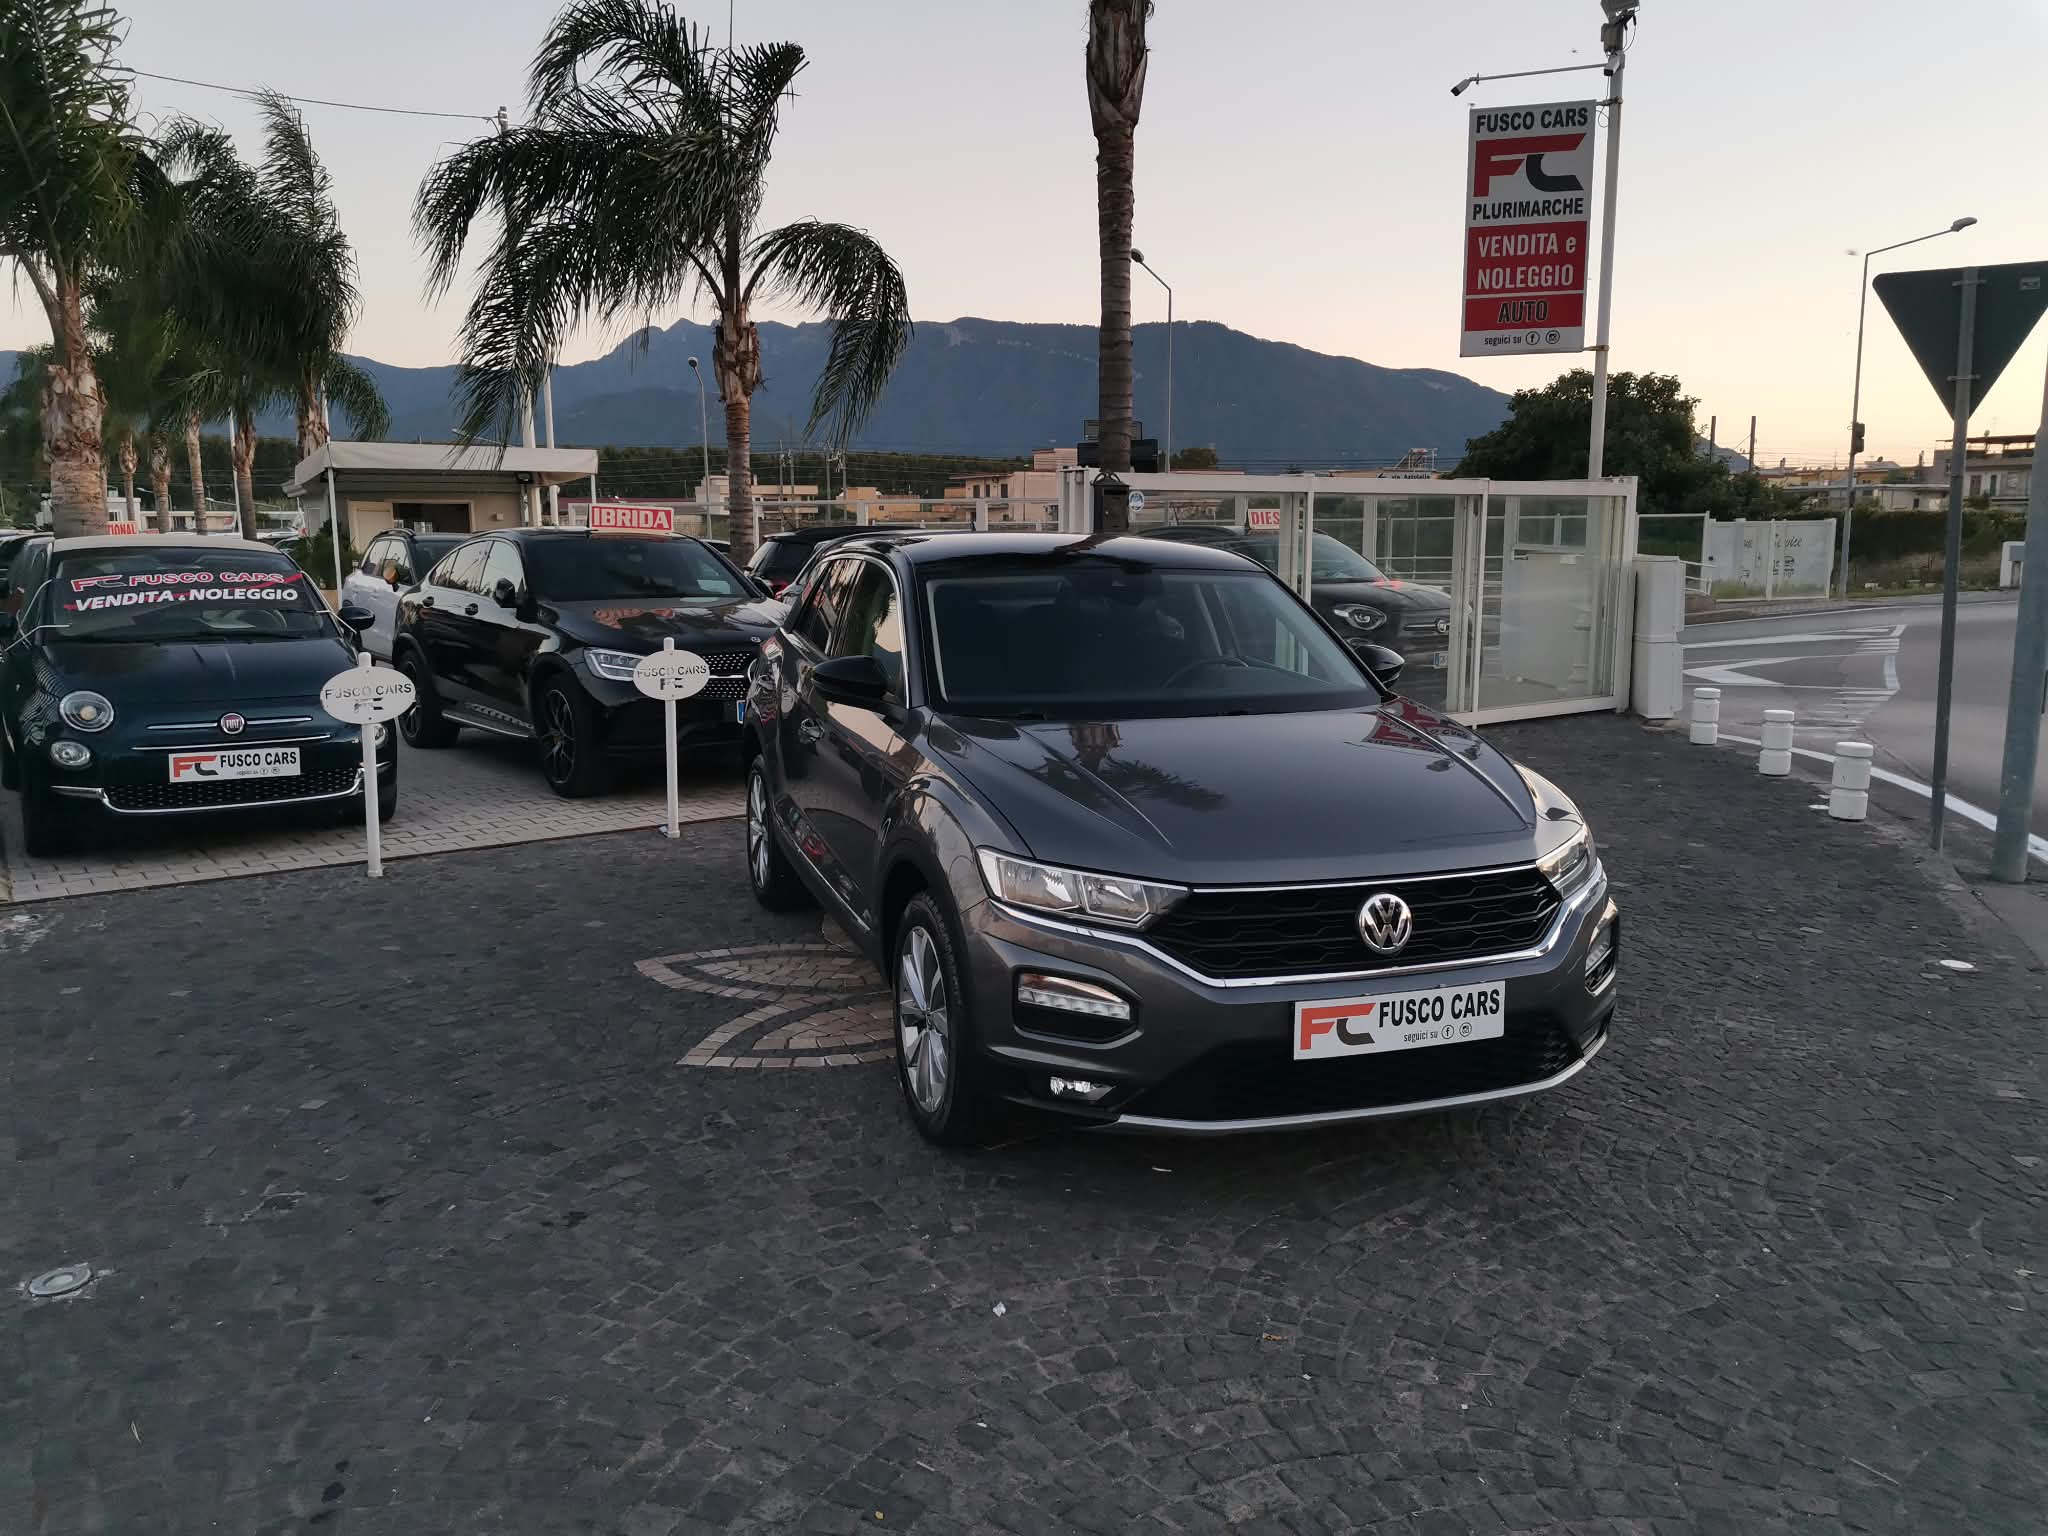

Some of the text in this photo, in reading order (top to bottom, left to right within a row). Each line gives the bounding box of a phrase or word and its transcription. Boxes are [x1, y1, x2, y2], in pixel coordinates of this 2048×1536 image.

[1476, 107, 1588, 134] FUSCO CARS
[1472, 197, 1584, 220] PLURIMARCHE
[1478, 233, 1577, 258] VENDITA e
[1477, 264, 1574, 290] NOLEGGIO
[1497, 299, 1549, 323] AUTO
[1484, 335, 1522, 347] seguici su
[594, 508, 669, 529] IBRIDA
[129, 572, 214, 587] FUSCO
[219, 572, 285, 584] CARS
[75, 590, 174, 611] VENDITA
[189, 588, 299, 601] NOLEGGIO
[677, 665, 708, 676] CARS
[375, 683, 412, 696] CARS
[220, 753, 261, 768] FUSCO
[264, 751, 297, 765] CARS
[1379, 996, 1444, 1028] FUSCO
[1451, 988, 1500, 1019] CARS
[1403, 1030, 1438, 1043] seguici su
